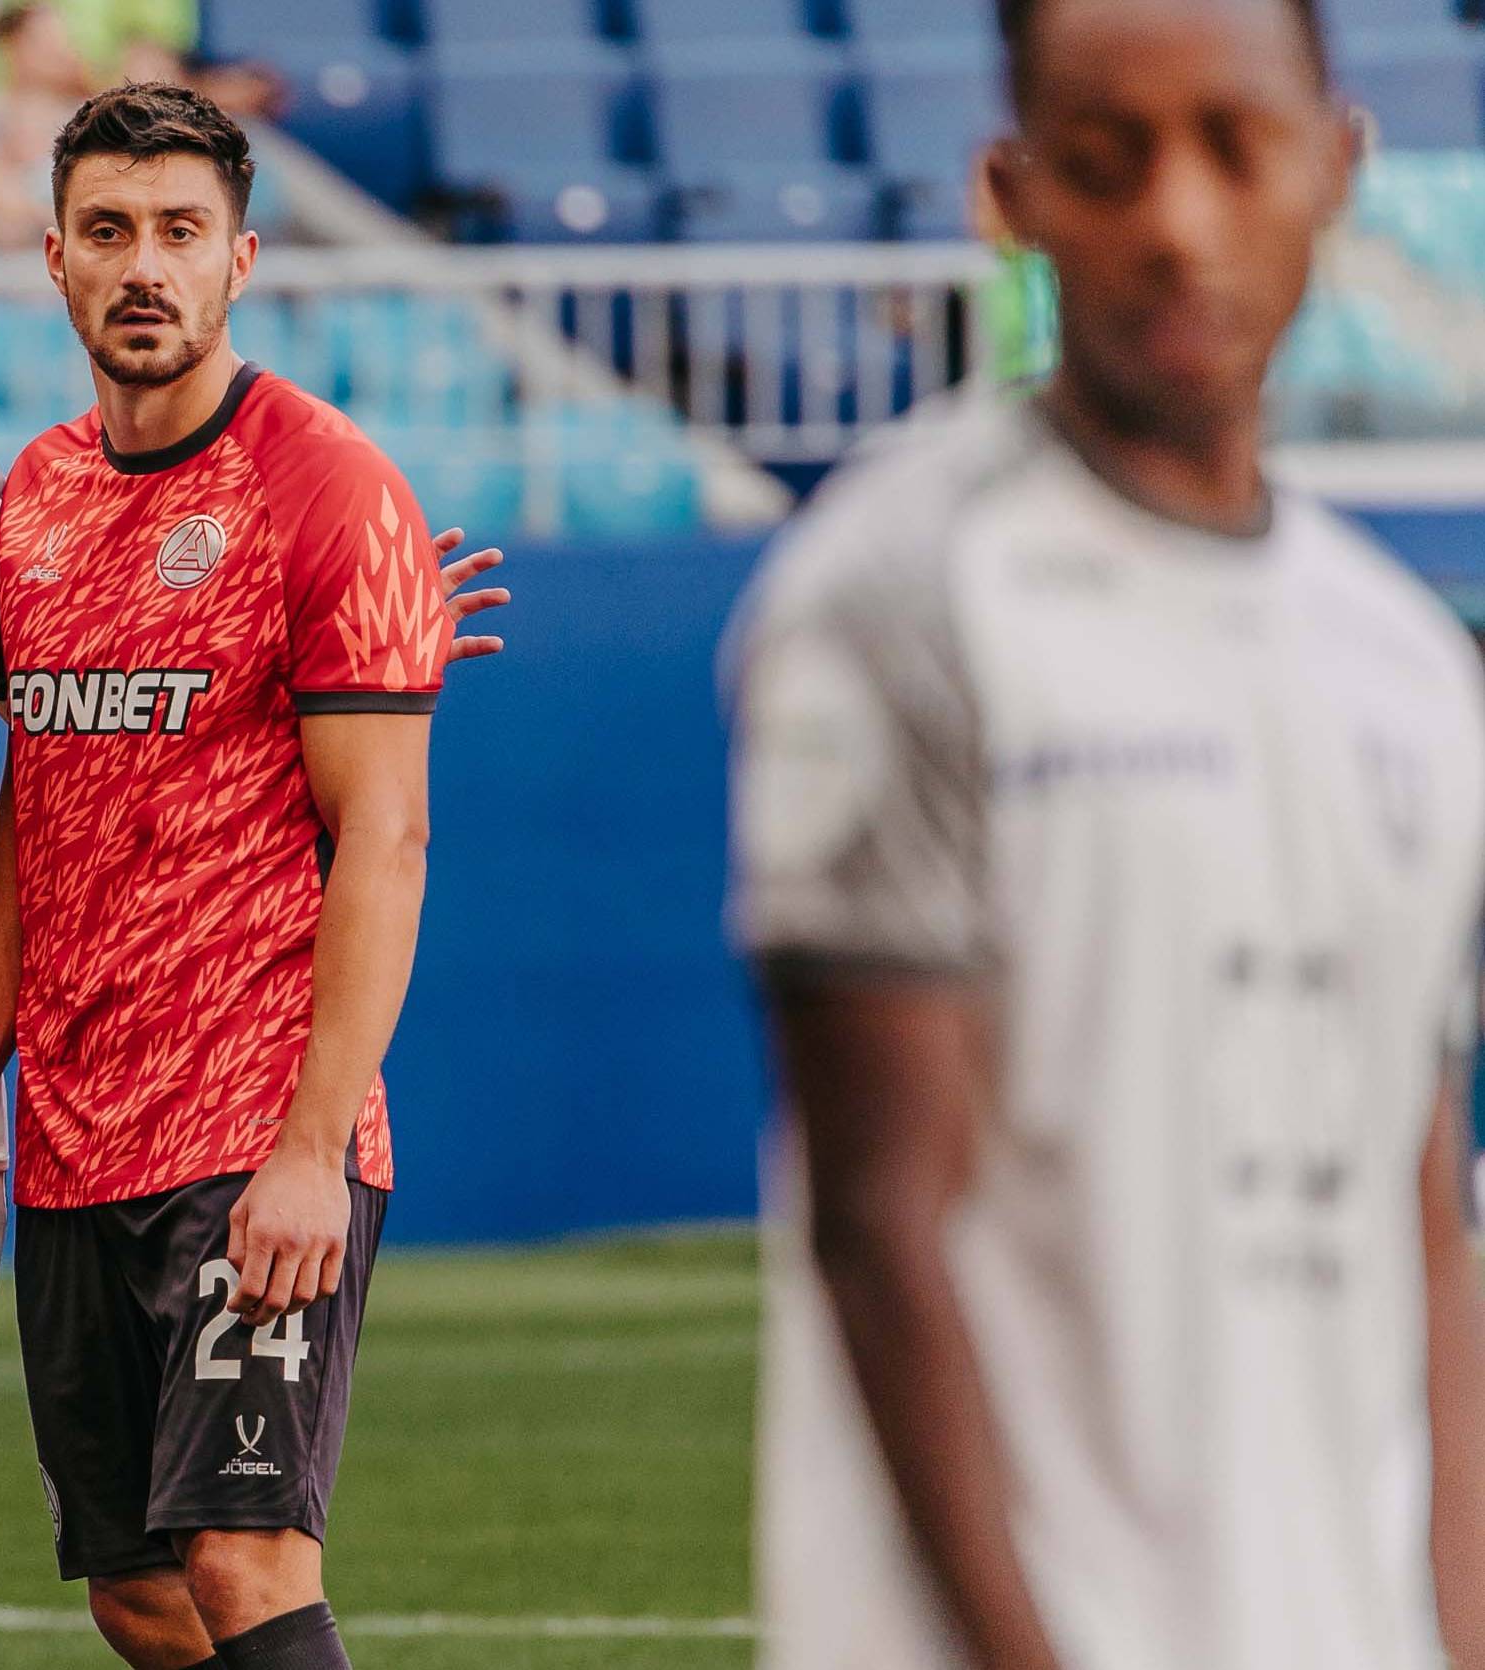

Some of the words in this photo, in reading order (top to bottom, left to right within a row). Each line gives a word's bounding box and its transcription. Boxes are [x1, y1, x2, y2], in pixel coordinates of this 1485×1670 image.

[9, 669, 215, 736] FONBET
[195, 1258, 311, 1382] 24
[218, 1458, 282, 1476] JÖGEL
